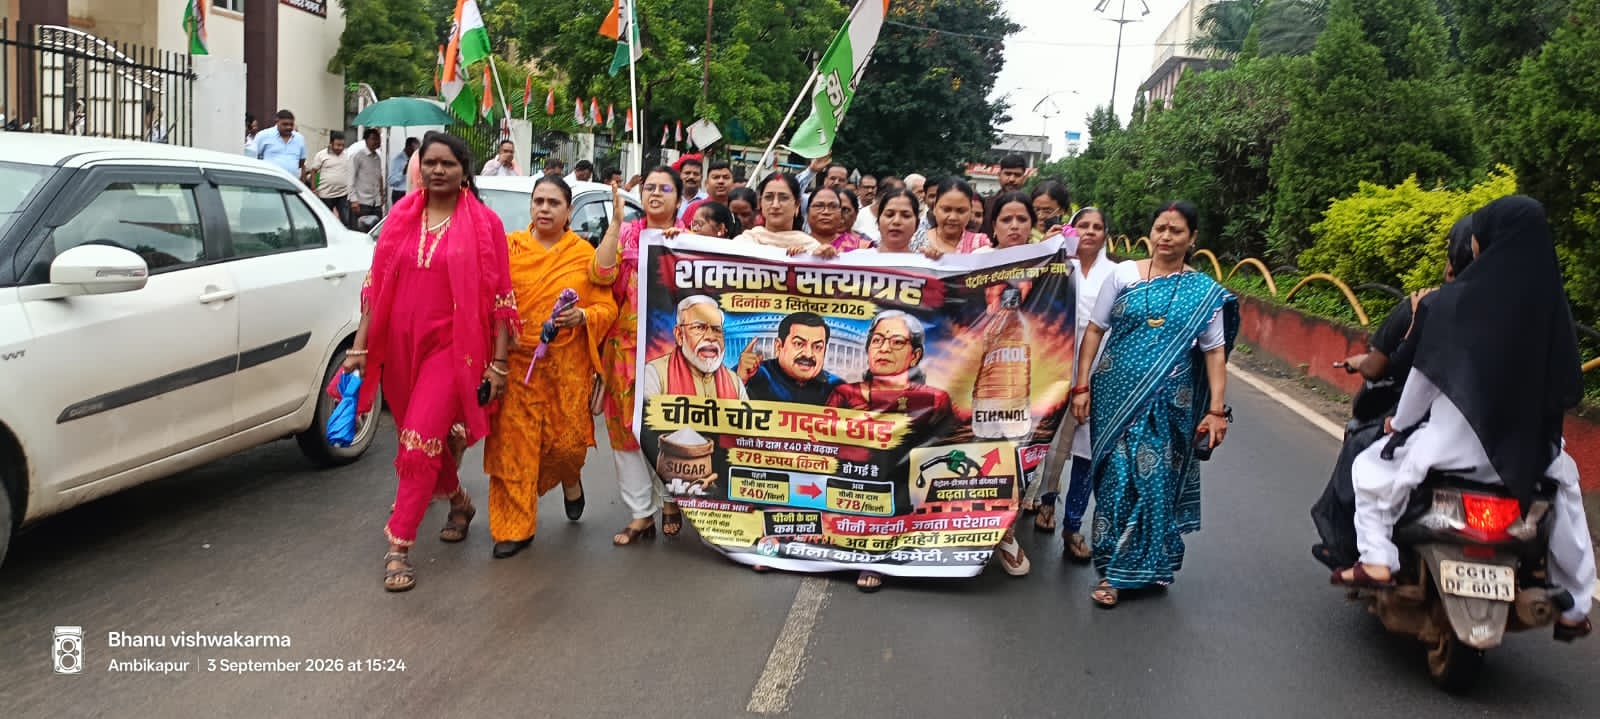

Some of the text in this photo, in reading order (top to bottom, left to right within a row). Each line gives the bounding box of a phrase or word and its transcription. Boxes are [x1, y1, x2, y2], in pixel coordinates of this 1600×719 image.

[794, 267, 927, 305] सत्याग्रह
[731, 295, 771, 309] दिनांक
[774, 299, 782, 310] 3
[831, 303, 865, 316] 2026
[661, 398, 720, 427] चीनी
[725, 402, 773, 431] चोर
[845, 412, 897, 449] छोड़
[975, 409, 1028, 423] ETHANOL
[736, 437, 754, 448] चीनी
[755, 438, 764, 448] के
[765, 441, 781, 449] दाम
[783, 441, 801, 451] ₹40
[803, 443, 811, 452] से
[736, 450, 762, 464] ₹78
[794, 455, 829, 471] किलो
[665, 463, 706, 475] SUGAR
[842, 462, 880, 477] हो गई है
[771, 512, 794, 523] चीनी
[796, 512, 804, 522] के
[836, 519, 865, 534] चीनी
[911, 518, 948, 530] जनता
[951, 515, 1002, 529] परेशान
[773, 522, 816, 534] कम करो
[872, 534, 901, 549] नहीं
[943, 531, 999, 544] अन्याय!
[785, 542, 830, 558] जिला
[1456, 565, 1497, 580] CG15
[1472, 583, 1511, 597] 6013
